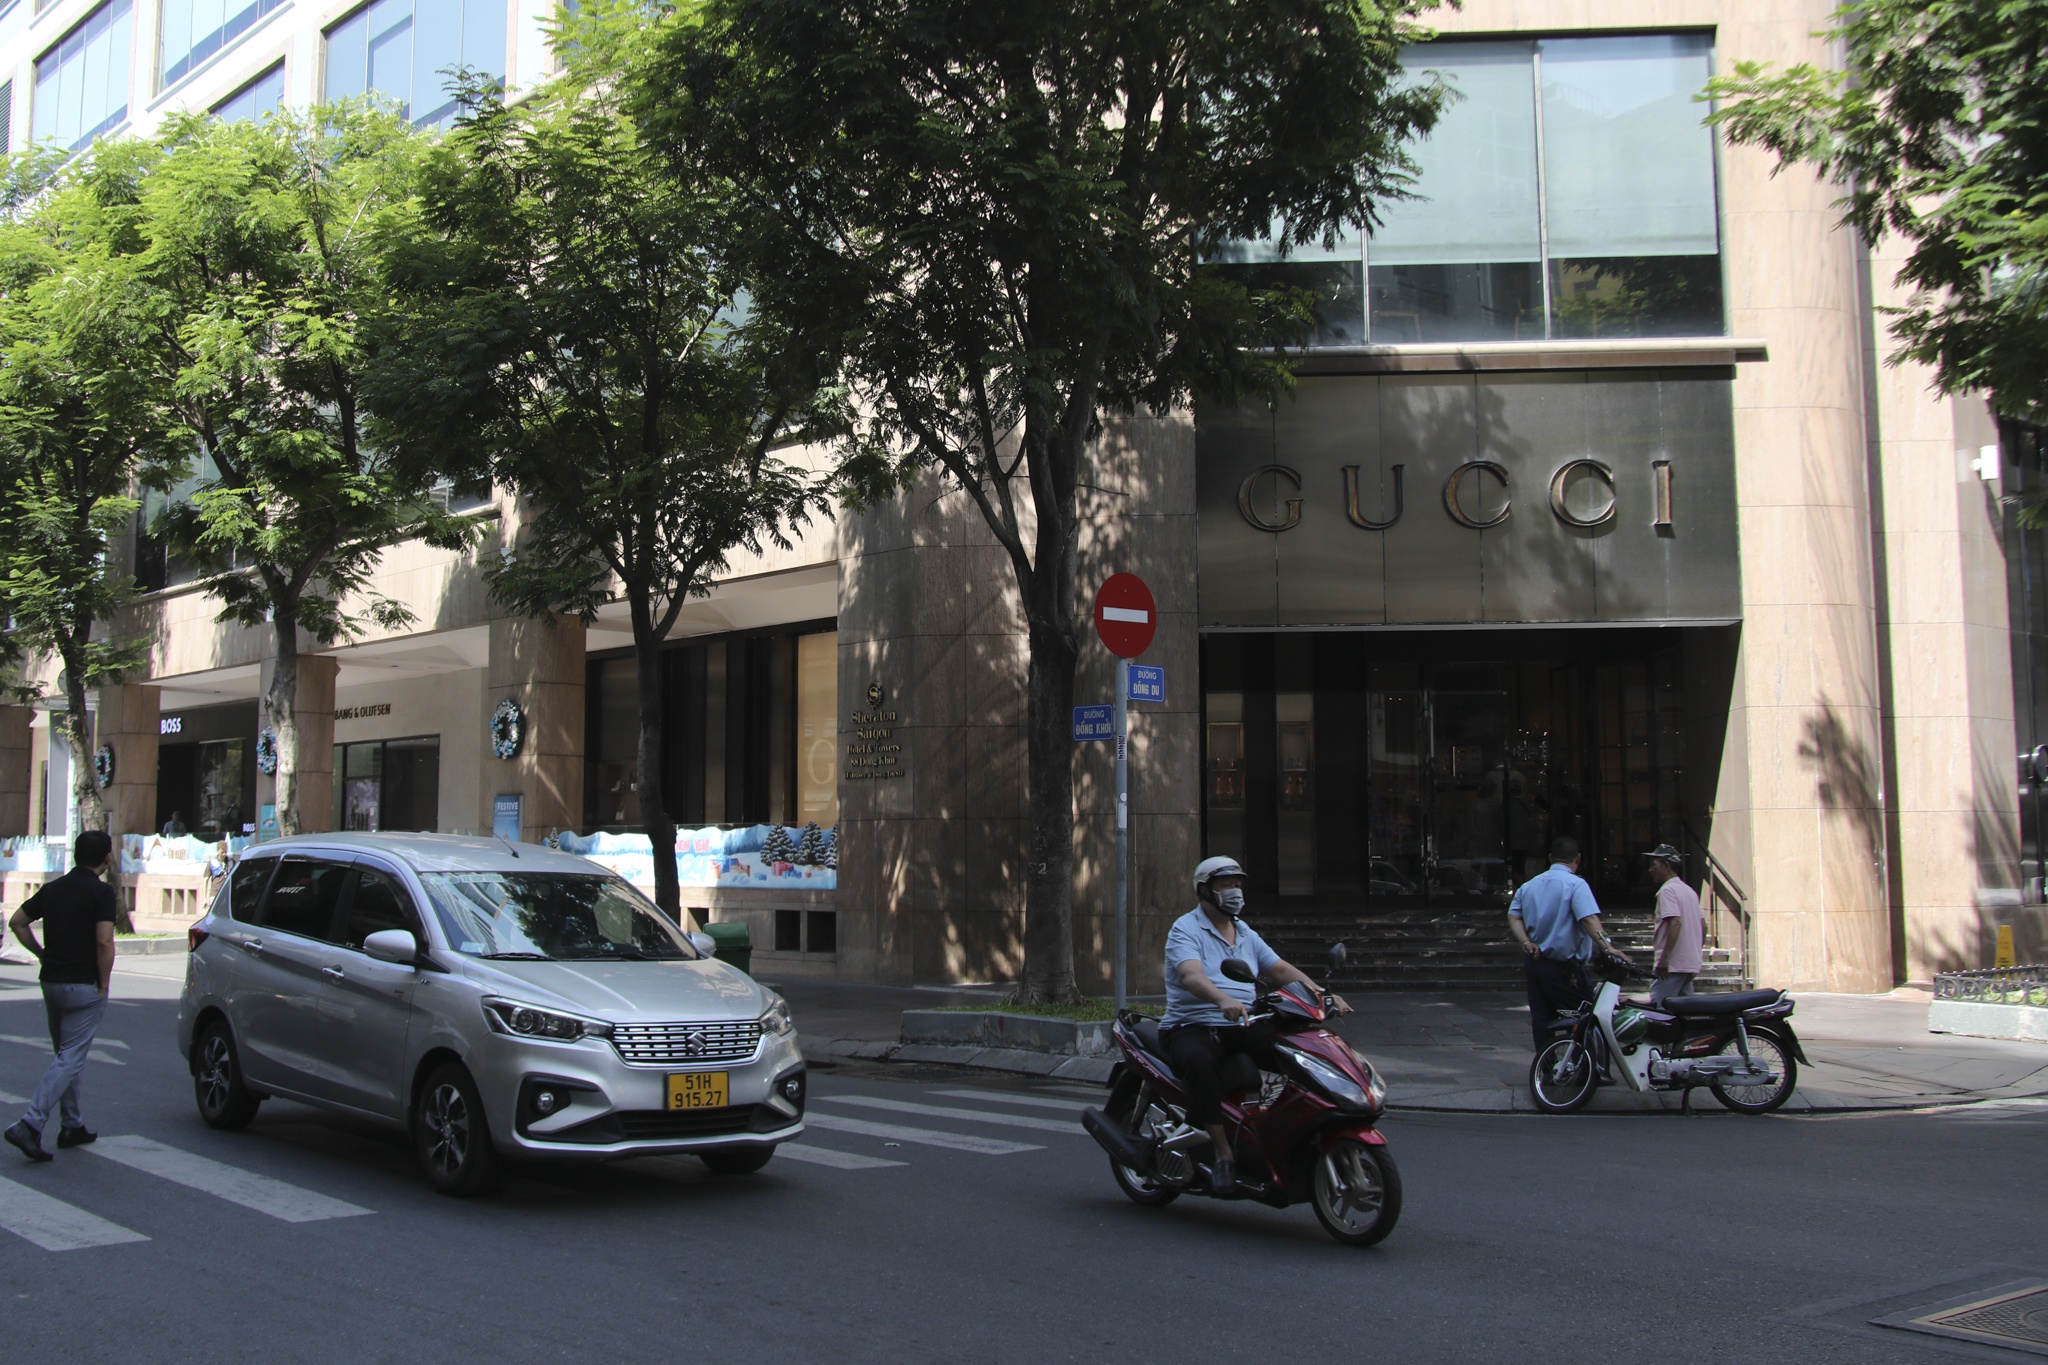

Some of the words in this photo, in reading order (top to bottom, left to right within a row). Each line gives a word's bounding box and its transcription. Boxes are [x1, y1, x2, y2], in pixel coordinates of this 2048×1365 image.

[1239, 458, 1674, 532] GUCCI
[1137, 669, 1157, 680] ĐƯỜNG
[1133, 681, 1149, 695] ĐÔNG
[1151, 685, 1160, 696] DU
[335, 708, 353, 720] BANG
[354, 707, 359, 719] &
[360, 703, 391, 717] OLUFSEN
[851, 710, 897, 723] Sheraton
[1083, 709, 1105, 719] ĐƯỜNG
[160, 717, 182, 734] BOSS
[1075, 719, 1094, 735] ĐỒNG
[1096, 718, 1111, 734] KHỞI
[857, 726, 891, 741] Saigon
[847, 744, 866, 754] Hotel
[866, 744, 873, 753] &
[497, 801, 519, 811] FESTIVE
[242, 823, 255, 832] BOSS
[685, 1074, 711, 1090] 51H
[674, 1090, 722, 1108] 915.27
